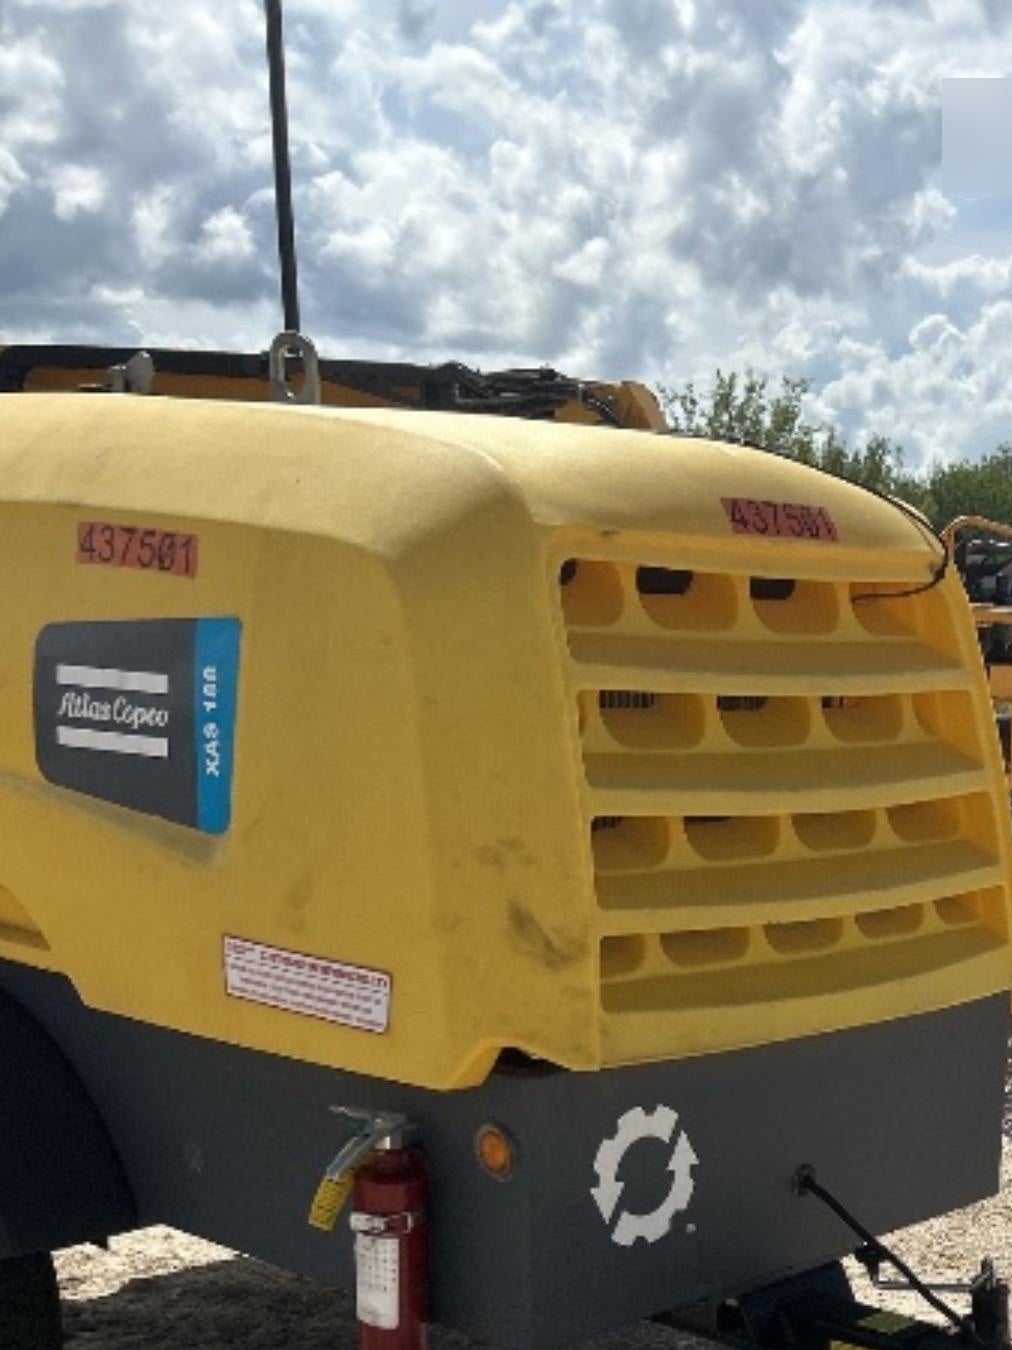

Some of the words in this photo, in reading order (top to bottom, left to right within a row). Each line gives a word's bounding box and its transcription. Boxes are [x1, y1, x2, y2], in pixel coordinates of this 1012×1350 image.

[79, 524, 193, 575] 437501
[57, 690, 111, 721] Atlas
[113, 695, 168, 729] Copco
[203, 722, 220, 777] XAS
